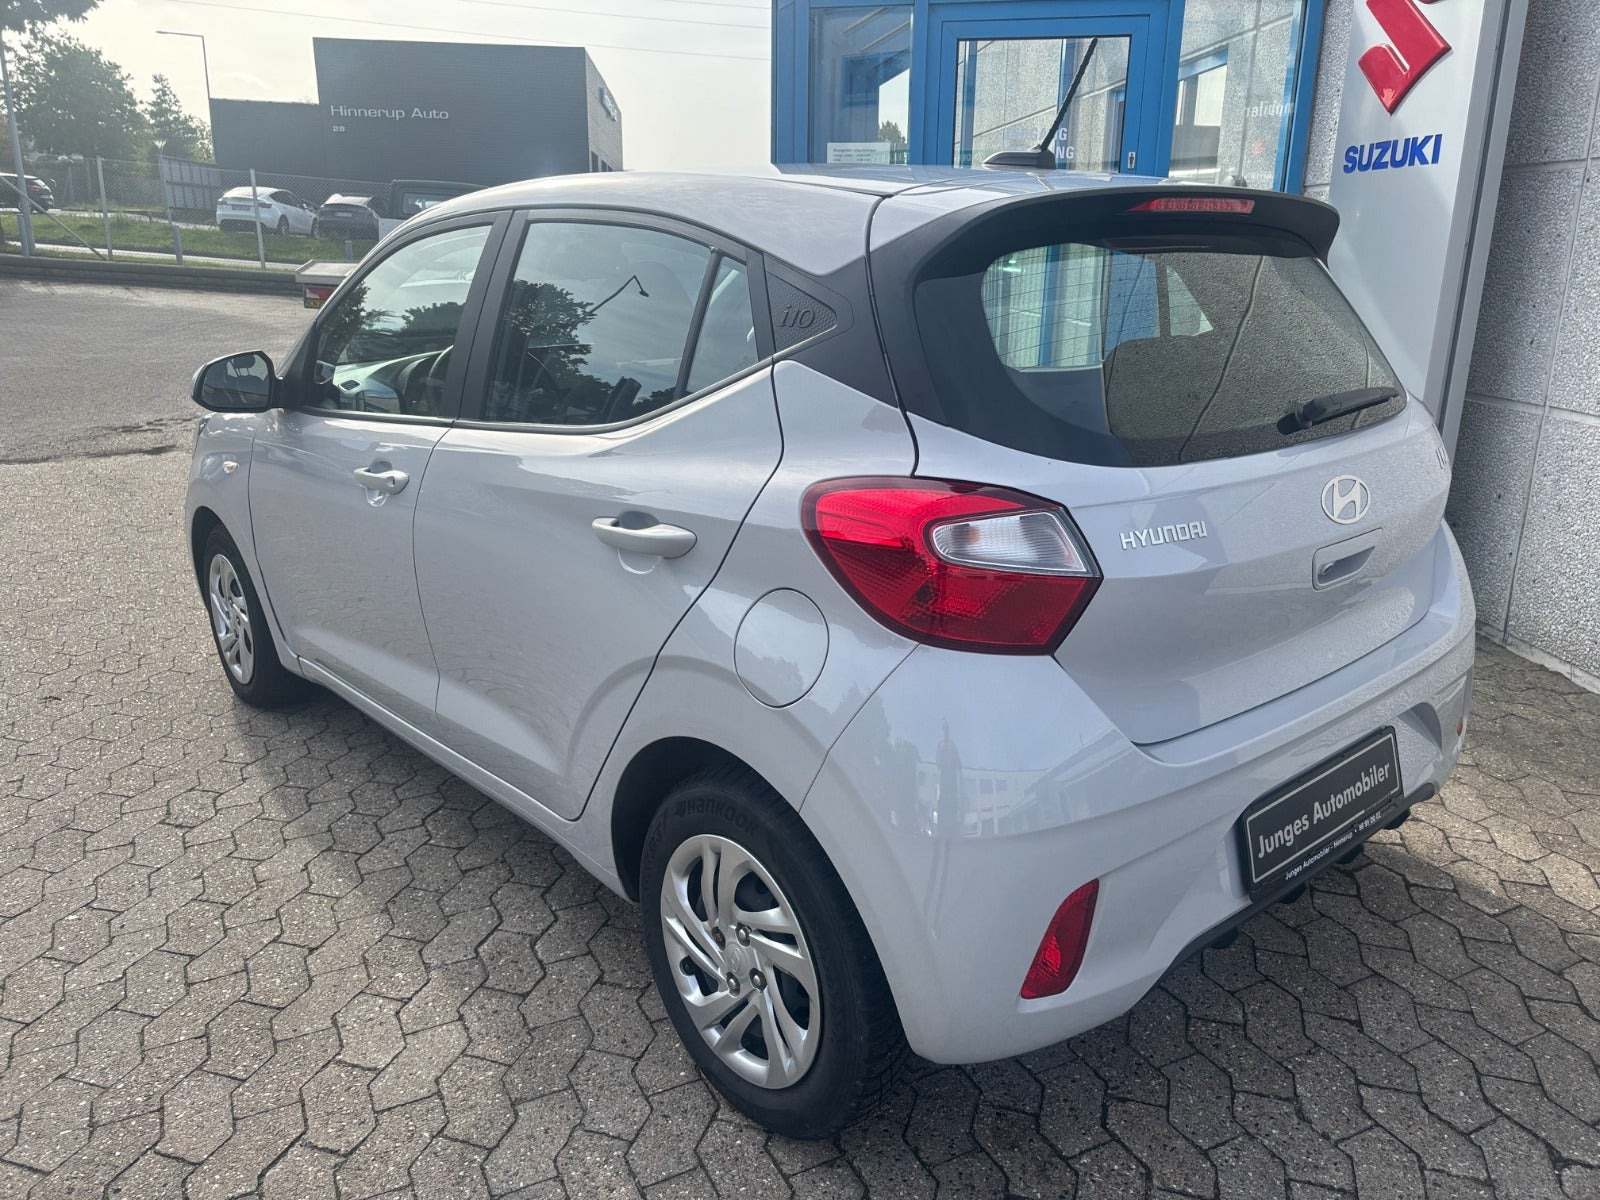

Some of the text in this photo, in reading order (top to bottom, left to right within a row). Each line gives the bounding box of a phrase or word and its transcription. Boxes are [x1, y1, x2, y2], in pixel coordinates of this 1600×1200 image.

[330, 104, 449, 120] Hinnerup Auto
[1343, 133, 1443, 174] SUZUKI
[1119, 520, 1208, 550] HYUNDAI
[1258, 762, 1391, 859] Junges Automobiler
[1285, 864, 1303, 880] Junges
